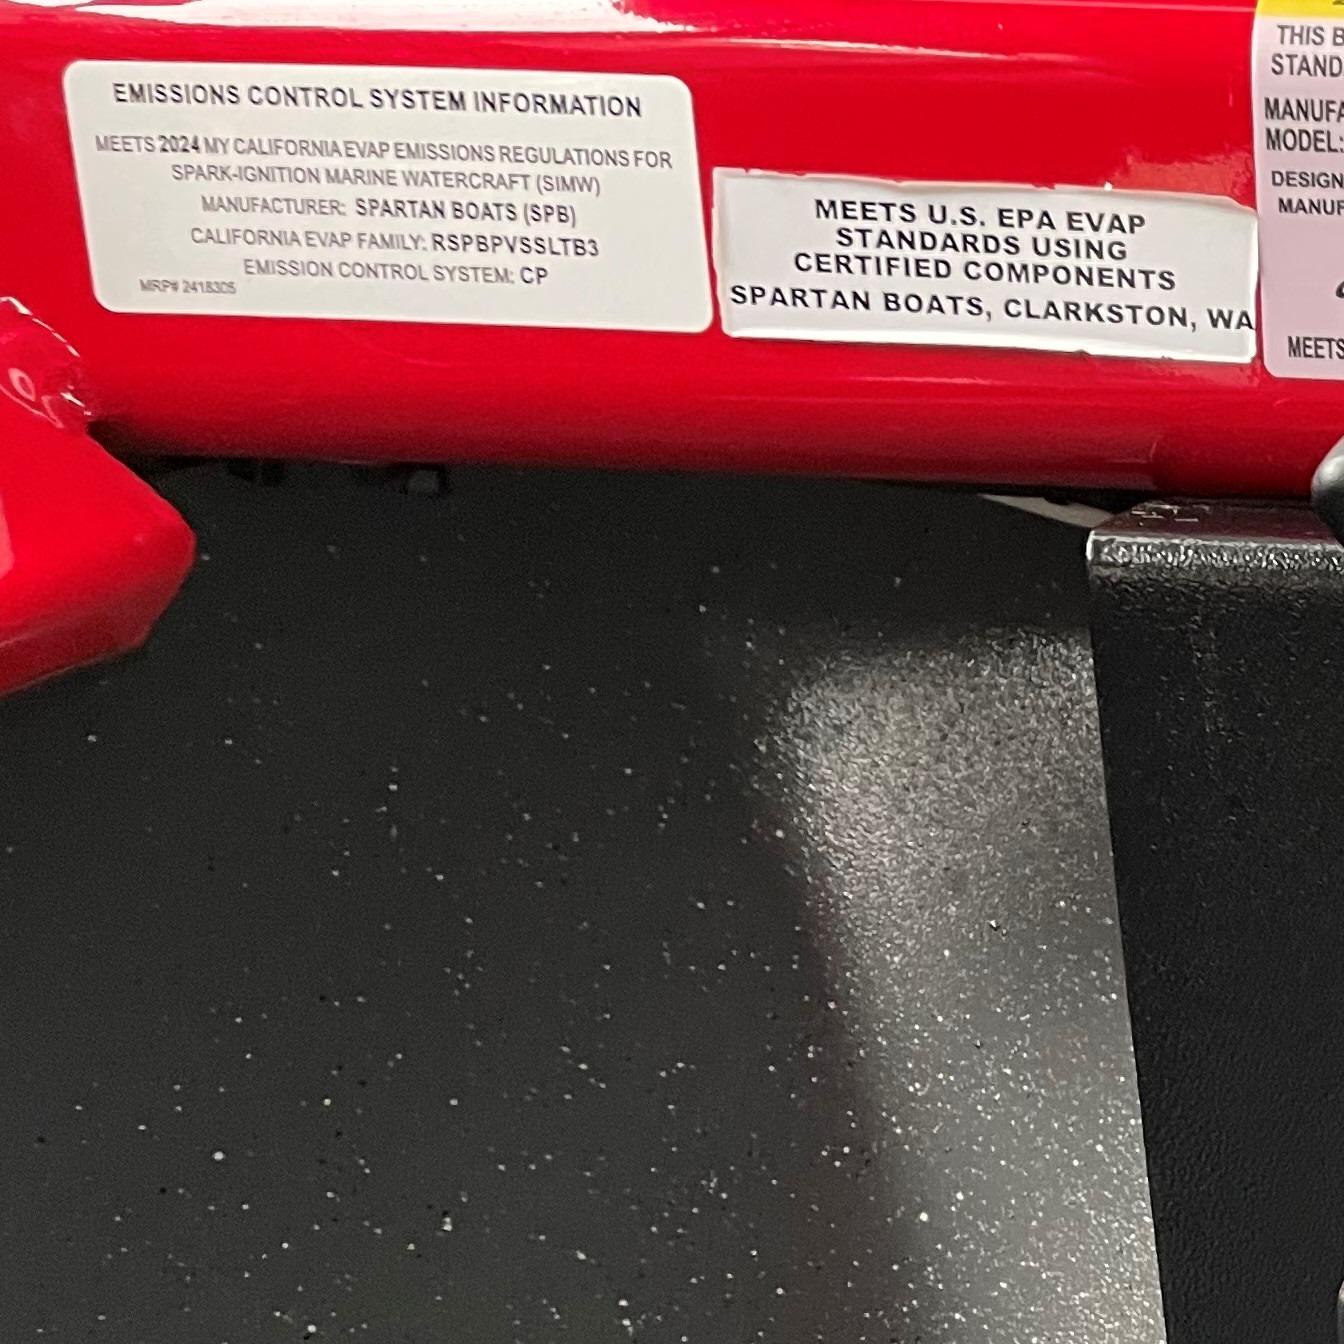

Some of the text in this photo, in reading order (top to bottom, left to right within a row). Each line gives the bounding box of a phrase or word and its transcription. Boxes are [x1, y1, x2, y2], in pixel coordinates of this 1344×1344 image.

[1277, 24, 1325, 46] THIS
[112, 83, 641, 117] EMISSIONS CONTROL SYSTEM INFORMATION
[96, 135, 672, 169] MEETS 2024 MY CALIFORNIA EVAP EMISSIONS REGULATIONS FOR
[1266, 127, 1344, 153] MODEL:
[171, 164, 601, 197] SPARK-IGNITION MARINE WATERCRAFT (SIMW)
[1271, 170, 1343, 189] DESIGN
[201, 195, 576, 228] MANUFACTURER: SPARTAN BOATS (SPB)
[814, 199, 1146, 235] MEETS U.S. EPA EVAP
[191, 228, 301, 247] CALIFORNIA
[305, 230, 351, 249] EVAP
[358, 233, 427, 251] FAMILY:
[836, 228, 1128, 261] STANDARDS USING
[243, 259, 548, 285] EMISSION CONTROL SYSTEM: CP
[794, 252, 1176, 291] CERTIFIED COMPONENTS
[730, 285, 1253, 333] SPARTAN BOATS, CLARKSTON, WA
